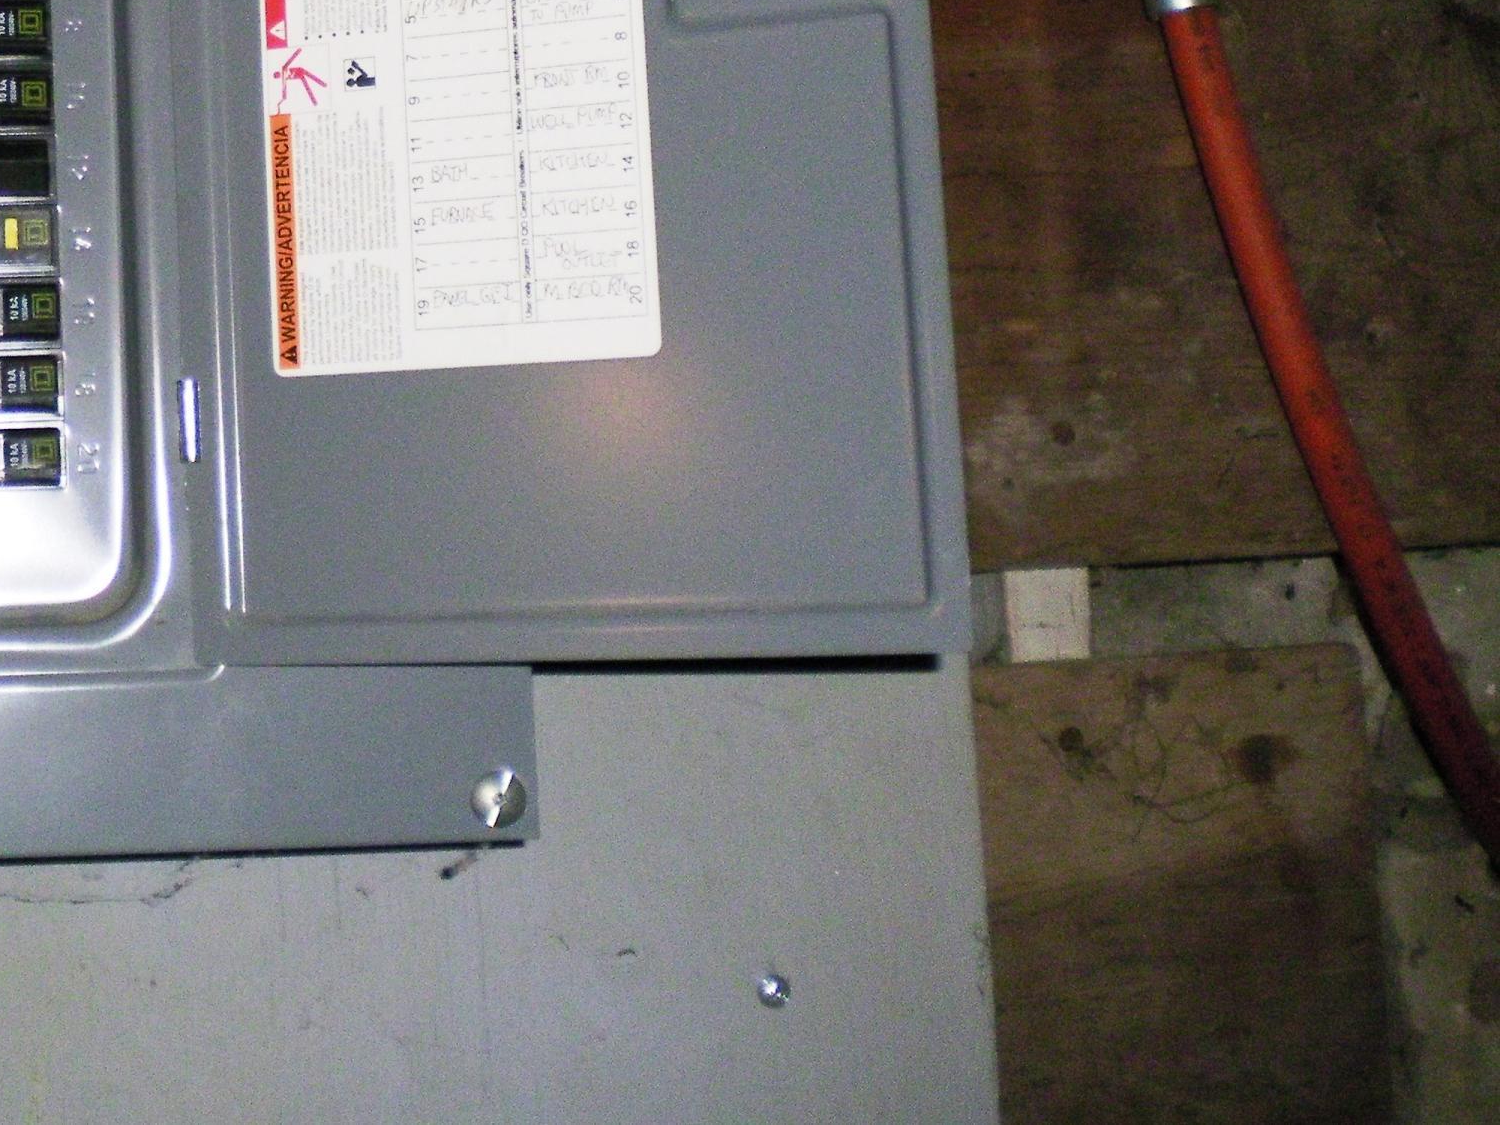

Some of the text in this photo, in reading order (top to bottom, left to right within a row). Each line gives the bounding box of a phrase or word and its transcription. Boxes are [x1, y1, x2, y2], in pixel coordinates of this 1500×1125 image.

[404, 14, 417, 24] 5
[614, 31, 627, 40] 8
[616, 71, 630, 89] 10
[408, 96, 420, 106] 9
[619, 112, 632, 129] 12
[410, 137, 422, 153] 11
[621, 155, 635, 173] 14
[412, 175, 425, 192] 13
[624, 200, 638, 217] 16
[273, 125, 297, 343] WARNING/ADVERTENCIA
[414, 217, 427, 234] 15
[626, 239, 640, 257] 18
[415, 257, 428, 272] 17
[629, 285, 643, 304] 20
[417, 299, 430, 316] 19
